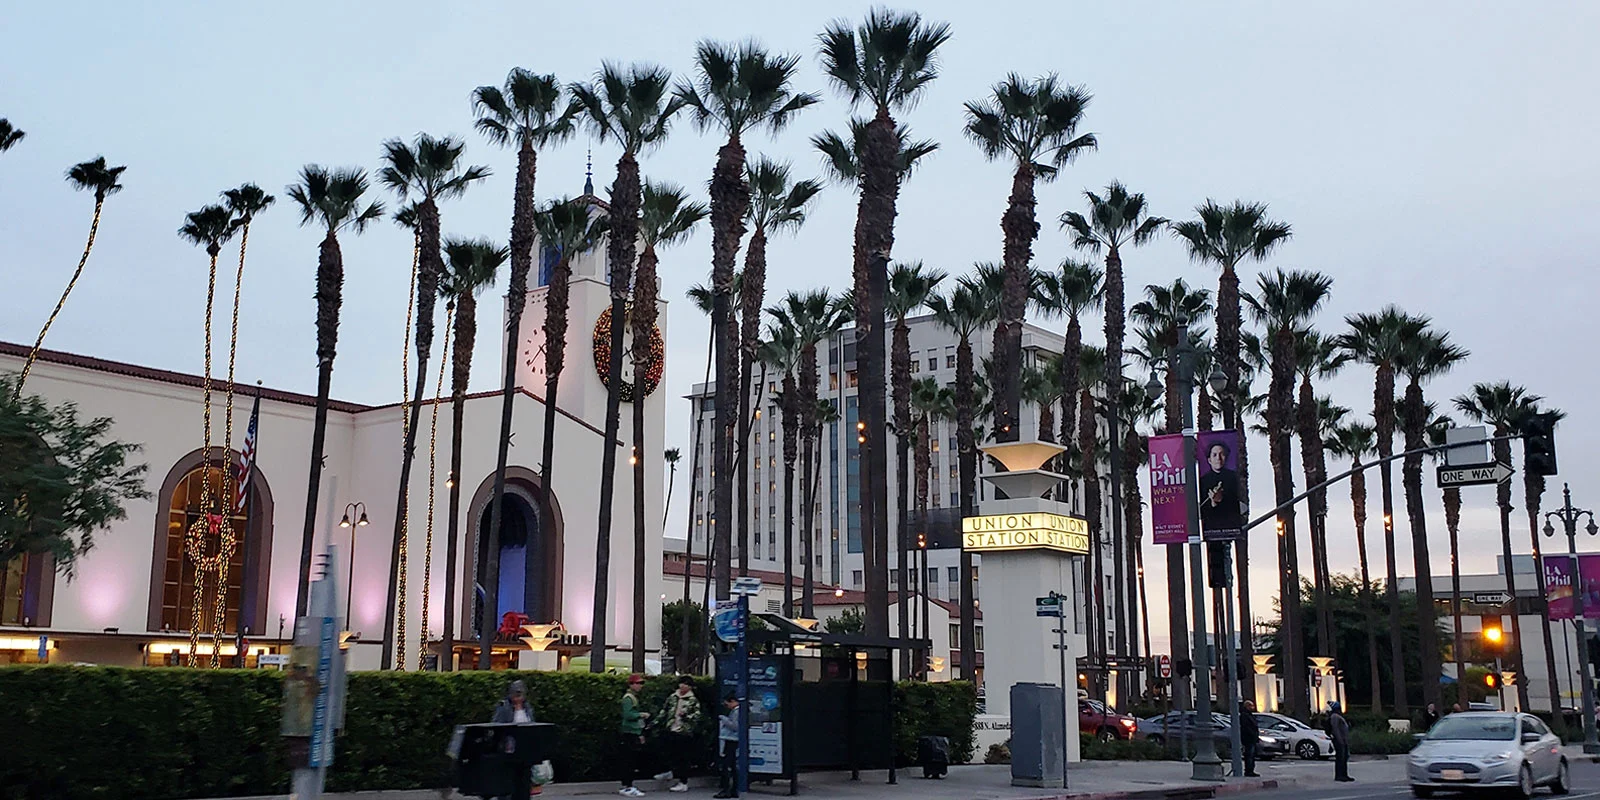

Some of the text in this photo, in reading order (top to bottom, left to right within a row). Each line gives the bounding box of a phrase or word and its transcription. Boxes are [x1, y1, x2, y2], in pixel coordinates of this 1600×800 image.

[1151, 453, 1172, 469] LA
[1152, 467, 1186, 486] Phil
[1442, 469, 1495, 482] ONE WAY
[1153, 486, 1184, 496] WHAT'S
[1154, 496, 1175, 504] NEXT
[972, 515, 1032, 531] UNION
[1050, 516, 1084, 532] UNION
[967, 531, 1039, 546] STATION
[1047, 532, 1088, 549] STATION
[1546, 566, 1561, 575] LA
[1547, 575, 1571, 585] Phil
